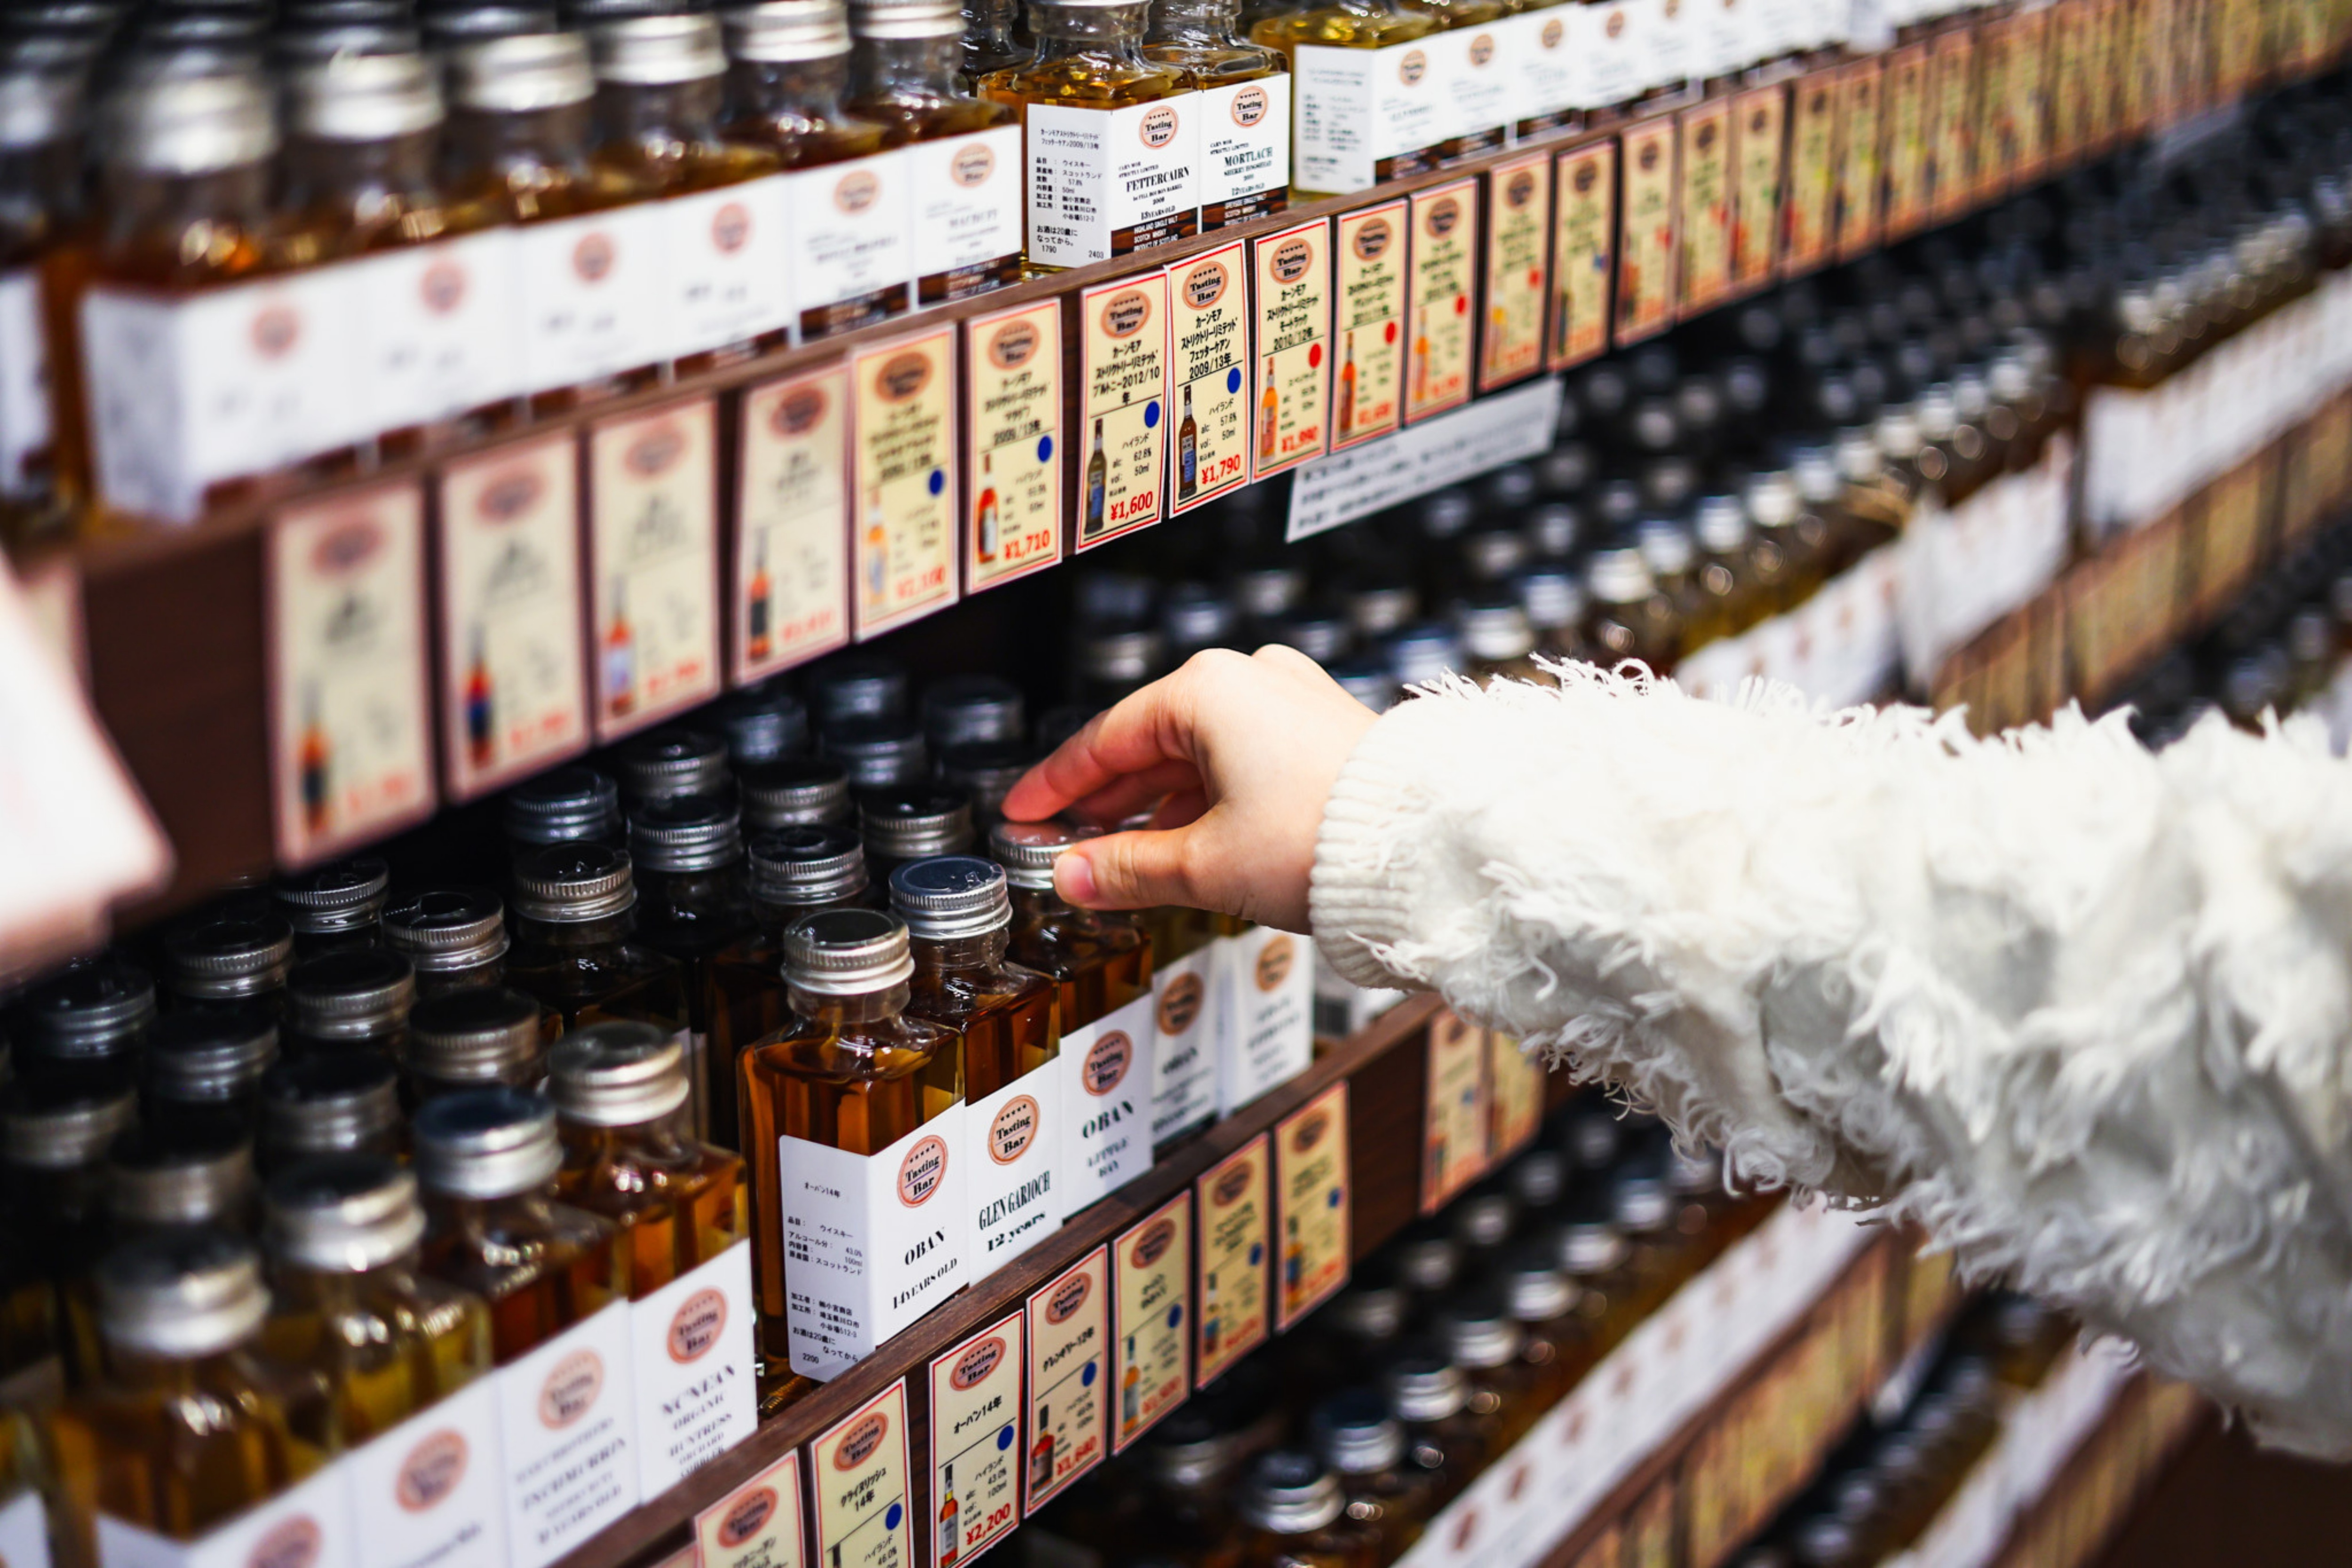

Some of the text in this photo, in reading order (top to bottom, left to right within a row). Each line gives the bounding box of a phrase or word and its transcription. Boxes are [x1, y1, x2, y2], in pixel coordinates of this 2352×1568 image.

[1237, 101, 1263, 111] Tasting
[1145, 121, 1172, 132] Tasting
[1152, 133, 1168, 142] Bar
[1224, 147, 1273, 167] MORTLACH
[1063, 169, 1103, 179] スコットランド
[1126, 166, 1190, 192] FETTERCAIRN
[1036, 225, 1078, 237] お酒は20歳に
[1037, 235, 1073, 247] なってから。
[1042, 245, 1104, 259] 1790 2403
[1277, 253, 1307, 267] Tasting
[1283, 267, 1302, 277] Bar
[1189, 274, 1221, 292] Tasting
[1197, 289, 1217, 303] Bar
[1109, 305, 1144, 321] Tasting
[1195, 308, 1223, 329] カーンモア
[1116, 319, 1137, 332] Bar
[1181, 317, 1239, 350] ストリクトリーリミテッド
[1112, 339, 1142, 357] カーンモア
[1189, 338, 1231, 364] フェッターケアン
[1189, 352, 1232, 380] 2009/13年
[1122, 391, 1131, 407] 年
[1209, 398, 1234, 415] ハイランド
[1220, 412, 1237, 427] 57.8%
[1121, 432, 1150, 450] ハイランド
[1222, 427, 1236, 441] 50ml
[1134, 447, 1152, 462] 62.8%
[1134, 463, 1150, 477] 50ml
[1201, 454, 1240, 485] ¥1,790
[1110, 491, 1153, 521] ¥1,600
[1004, 528, 1051, 560] ¥1,710
[1089, 1049, 1124, 1072] Tasting
[1097, 1067, 1119, 1085] Bar
[996, 1114, 1032, 1140] Tasting
[1082, 1098, 1134, 1139] OBAN
[1003, 1134, 1025, 1155] Bar
[906, 1155, 940, 1183] Tasting
[805, 1181, 841, 1199] オーバン14年
[913, 1176, 935, 1196] Bar
[979, 1170, 1051, 1231] GLEN GARIOCH
[820, 1225, 854, 1238] ウイスキー
[987, 1210, 1046, 1252] 12 years
[846, 1247, 863, 1258] 43.0%
[905, 1226, 946, 1266] OBAN
[816, 1258, 863, 1275] スコットランド
[845, 1256, 863, 1267] 100ml
[937, 1258, 958, 1278] OLD
[677, 1311, 719, 1337] Tasting
[686, 1332, 713, 1353] Bar
[793, 1326, 836, 1345] お酒は20歳に
[802, 1352, 819, 1364] 2200
[823, 1345, 858, 1363] なってから
[960, 1349, 997, 1375] Tasting
[967, 1364, 991, 1383] Bar
[669, 1413, 733, 1457] HUNTRESS
[842, 1425, 880, 1454] Tasting
[850, 1440, 874, 1462] Bar
[975, 1455, 1004, 1481] ハイランド
[840, 1467, 887, 1508] クライヌリッシュ
[988, 1480, 1008, 1499] 100ml
[854, 1489, 875, 1512] 14年
[966, 1503, 1011, 1545] ¥2,200
[864, 1534, 893, 1562] ハイランド
